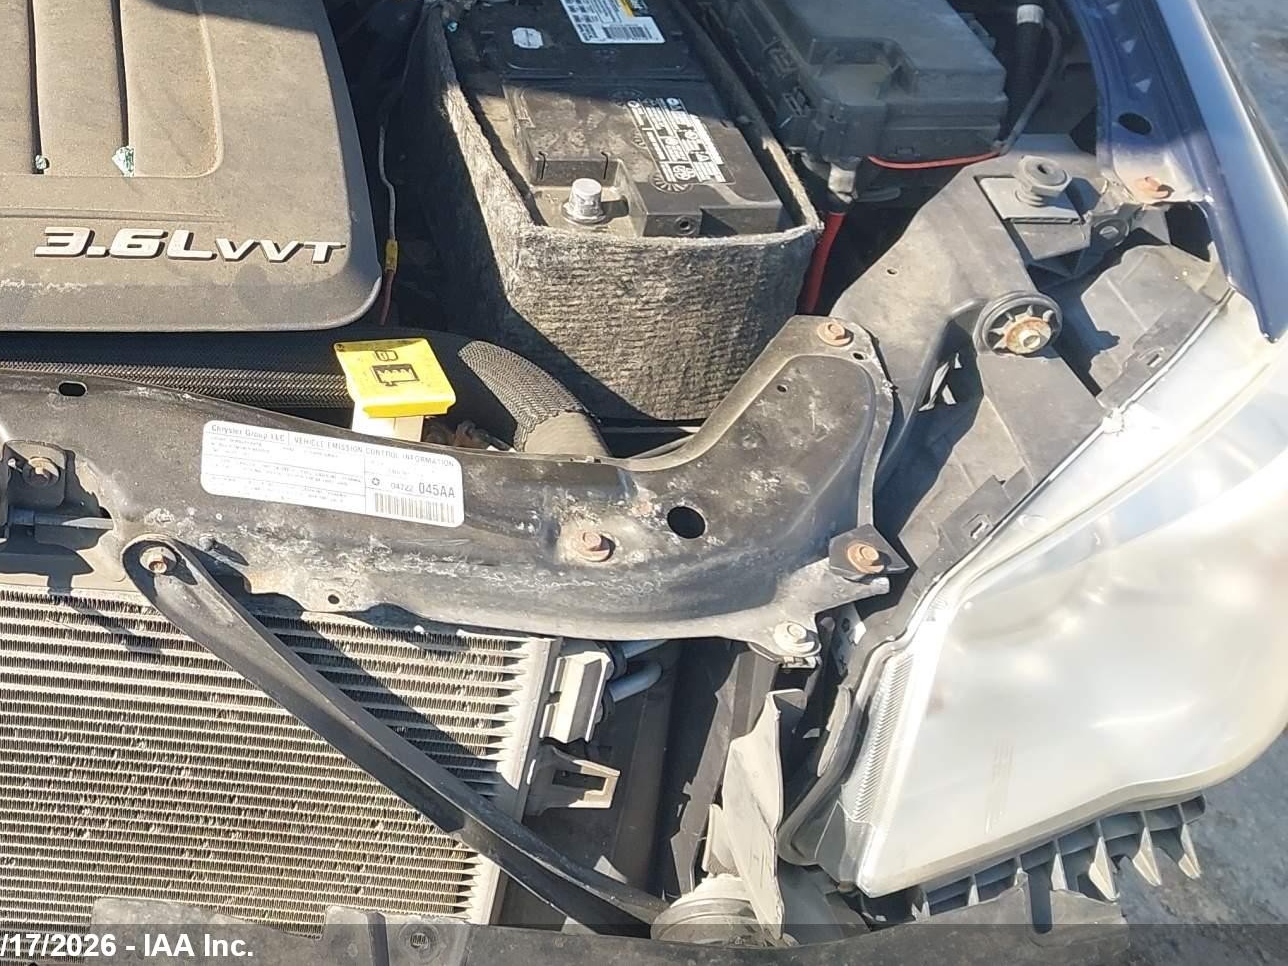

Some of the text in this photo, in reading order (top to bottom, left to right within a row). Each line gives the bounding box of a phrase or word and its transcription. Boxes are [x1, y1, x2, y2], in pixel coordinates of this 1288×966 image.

[211, 424, 243, 436] Chrysler
[245, 428, 268, 441] Group
[294, 436, 324, 448] VEHICLE
[327, 441, 363, 454] EMISSION
[365, 446, 400, 459] CONTROL
[402, 452, 454, 467] INFORMATION
[418, 481, 456, 499] 045AA
